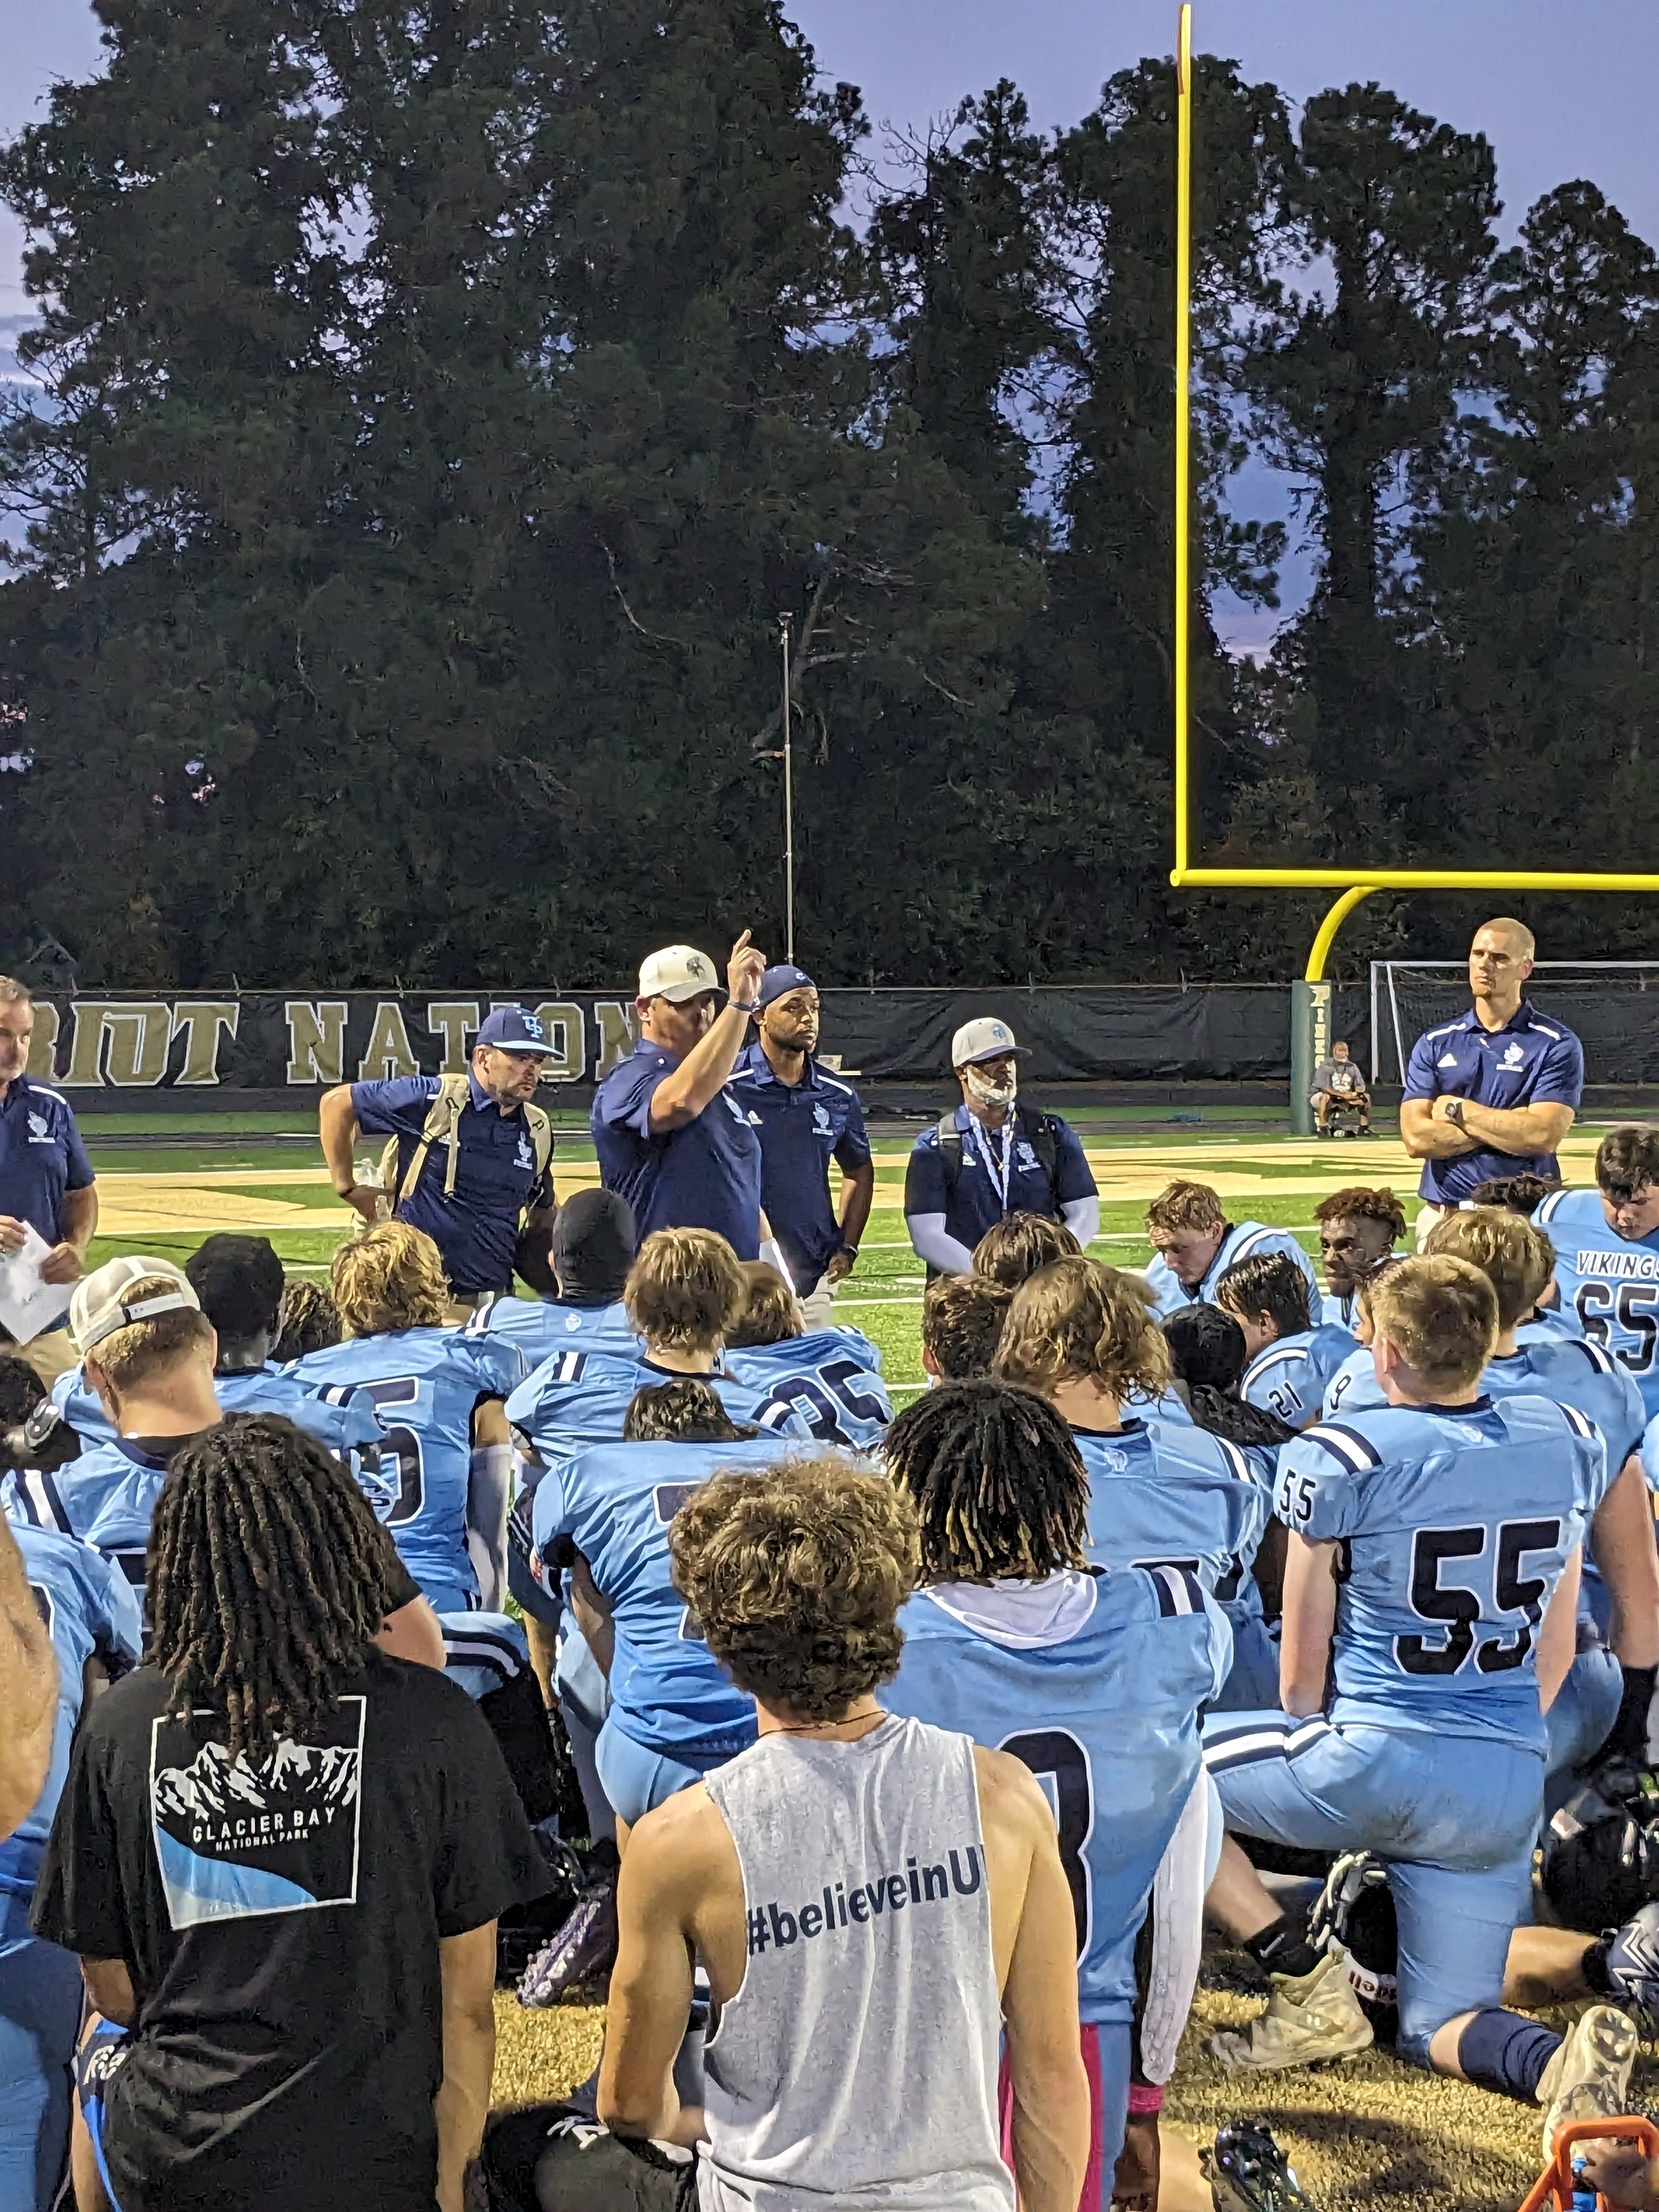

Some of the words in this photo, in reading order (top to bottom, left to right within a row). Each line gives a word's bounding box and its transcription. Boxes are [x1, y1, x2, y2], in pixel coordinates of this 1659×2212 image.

[285, 1001, 638, 1084] NATON
[1573, 1281, 1659, 1375] 65
[1267, 1380, 1304, 1420] 21
[1329, 1374, 1352, 1411] 9
[1278, 1467, 1317, 1522] 55
[1392, 1516, 1562, 1676] 55
[192, 1812, 284, 1844] GLACIER
[293, 1806, 335, 1826] BAY
[216, 1834, 275, 1852] NATIONAL
[279, 1828, 309, 1842] PARK
[748, 1846, 985, 1956] #believeinU
